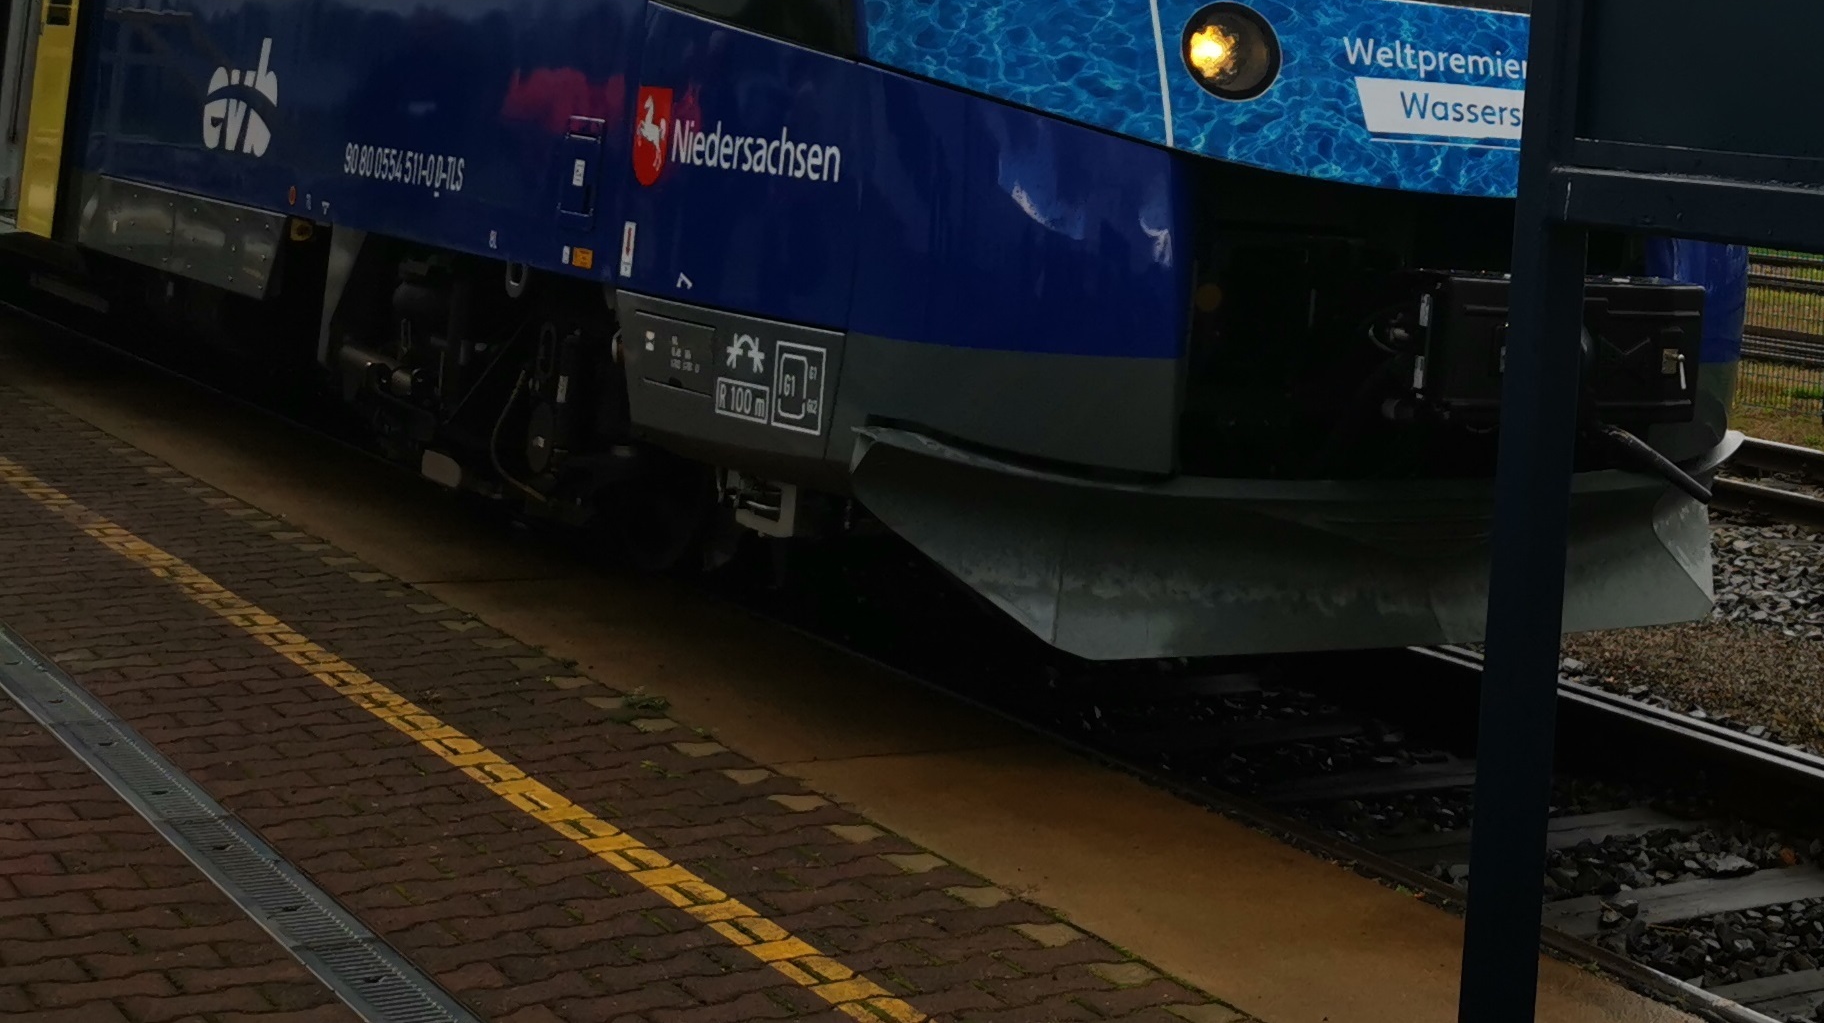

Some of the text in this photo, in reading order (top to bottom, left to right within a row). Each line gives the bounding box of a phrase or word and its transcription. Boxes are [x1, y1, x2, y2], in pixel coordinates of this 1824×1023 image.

[343, 142, 360, 174] 90
[359, 144, 375, 178] 80
[374, 146, 403, 183] 0554
[671, 118, 841, 184] Niedersachsen
[719, 383, 766, 418] R 100 m
[783, 374, 796, 397] G1
